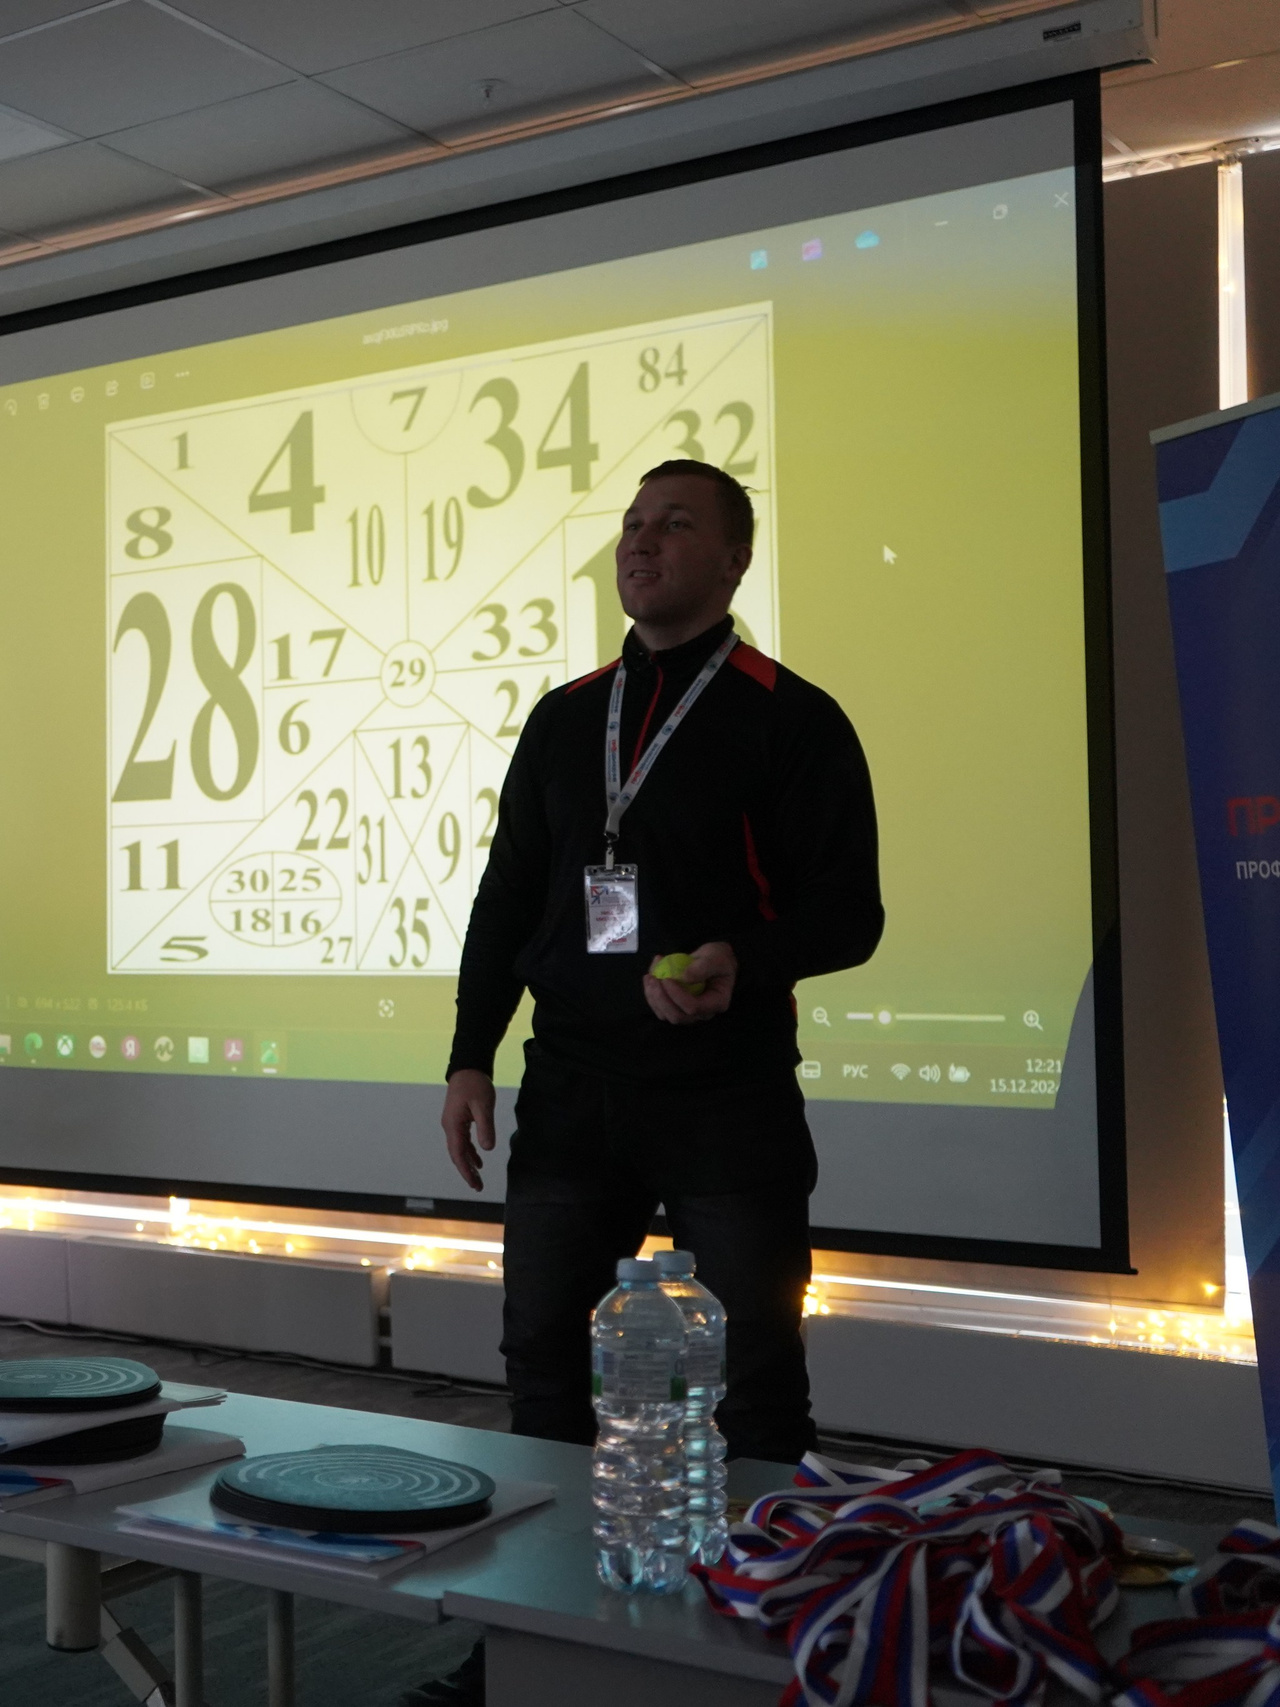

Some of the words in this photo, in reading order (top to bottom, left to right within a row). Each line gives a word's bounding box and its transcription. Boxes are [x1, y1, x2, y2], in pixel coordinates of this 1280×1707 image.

[638, 342, 687, 393] 84
[389, 386, 427, 432] 7
[466, 361, 599, 509] 34
[172, 431, 194, 471] 1
[662, 400, 759, 477] 32
[249, 410, 325, 534] 4
[124, 506, 174, 560] 8
[347, 504, 386, 588] 10
[422, 497, 464, 582] 19
[268, 628, 347, 682] 17
[471, 598, 559, 661] 33
[111, 582, 260, 803] 28
[389, 657, 426, 688] 29
[278, 698, 312, 756] 6
[388, 735, 432, 800] 13
[294, 788, 352, 851] 22
[438, 811, 461, 884] 9
[119, 838, 188, 892] 11
[358, 814, 389, 885] 31
[226, 869, 269, 894] 30
[278, 867, 323, 892] 25
[159, 935, 210, 963] 5
[228, 907, 272, 933] 18
[279, 909, 323, 936] 16
[388, 896, 431, 968] 35
[320, 937, 353, 964] 27
[843, 1064, 869, 1078] РУС
[1025, 1059, 1062, 1074] 12:21
